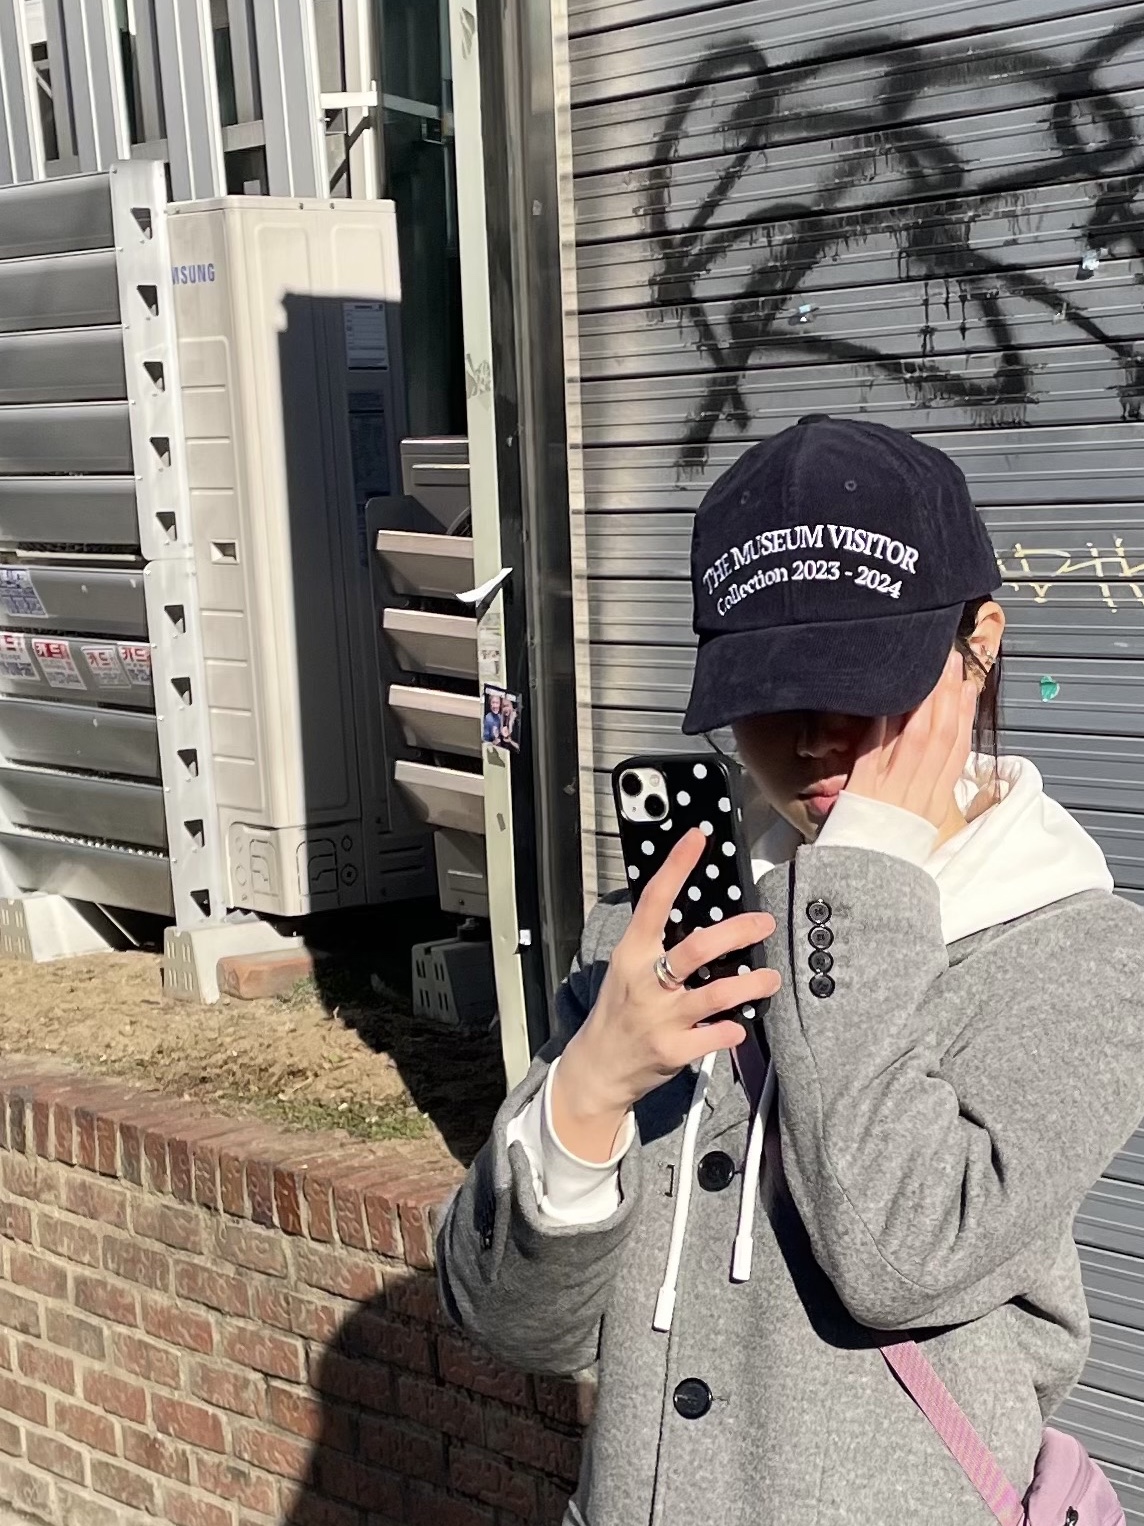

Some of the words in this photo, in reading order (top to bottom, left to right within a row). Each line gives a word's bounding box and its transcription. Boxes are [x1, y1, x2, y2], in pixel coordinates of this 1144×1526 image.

[171, 263, 215, 285] MSUNG
[703, 553, 733, 595] THE
[730, 524, 824, 571] MUSEUM
[827, 523, 920, 574] VISITOR
[716, 564, 789, 616] Collection
[791, 560, 841, 581] 2023
[854, 565, 903, 599] 2024
